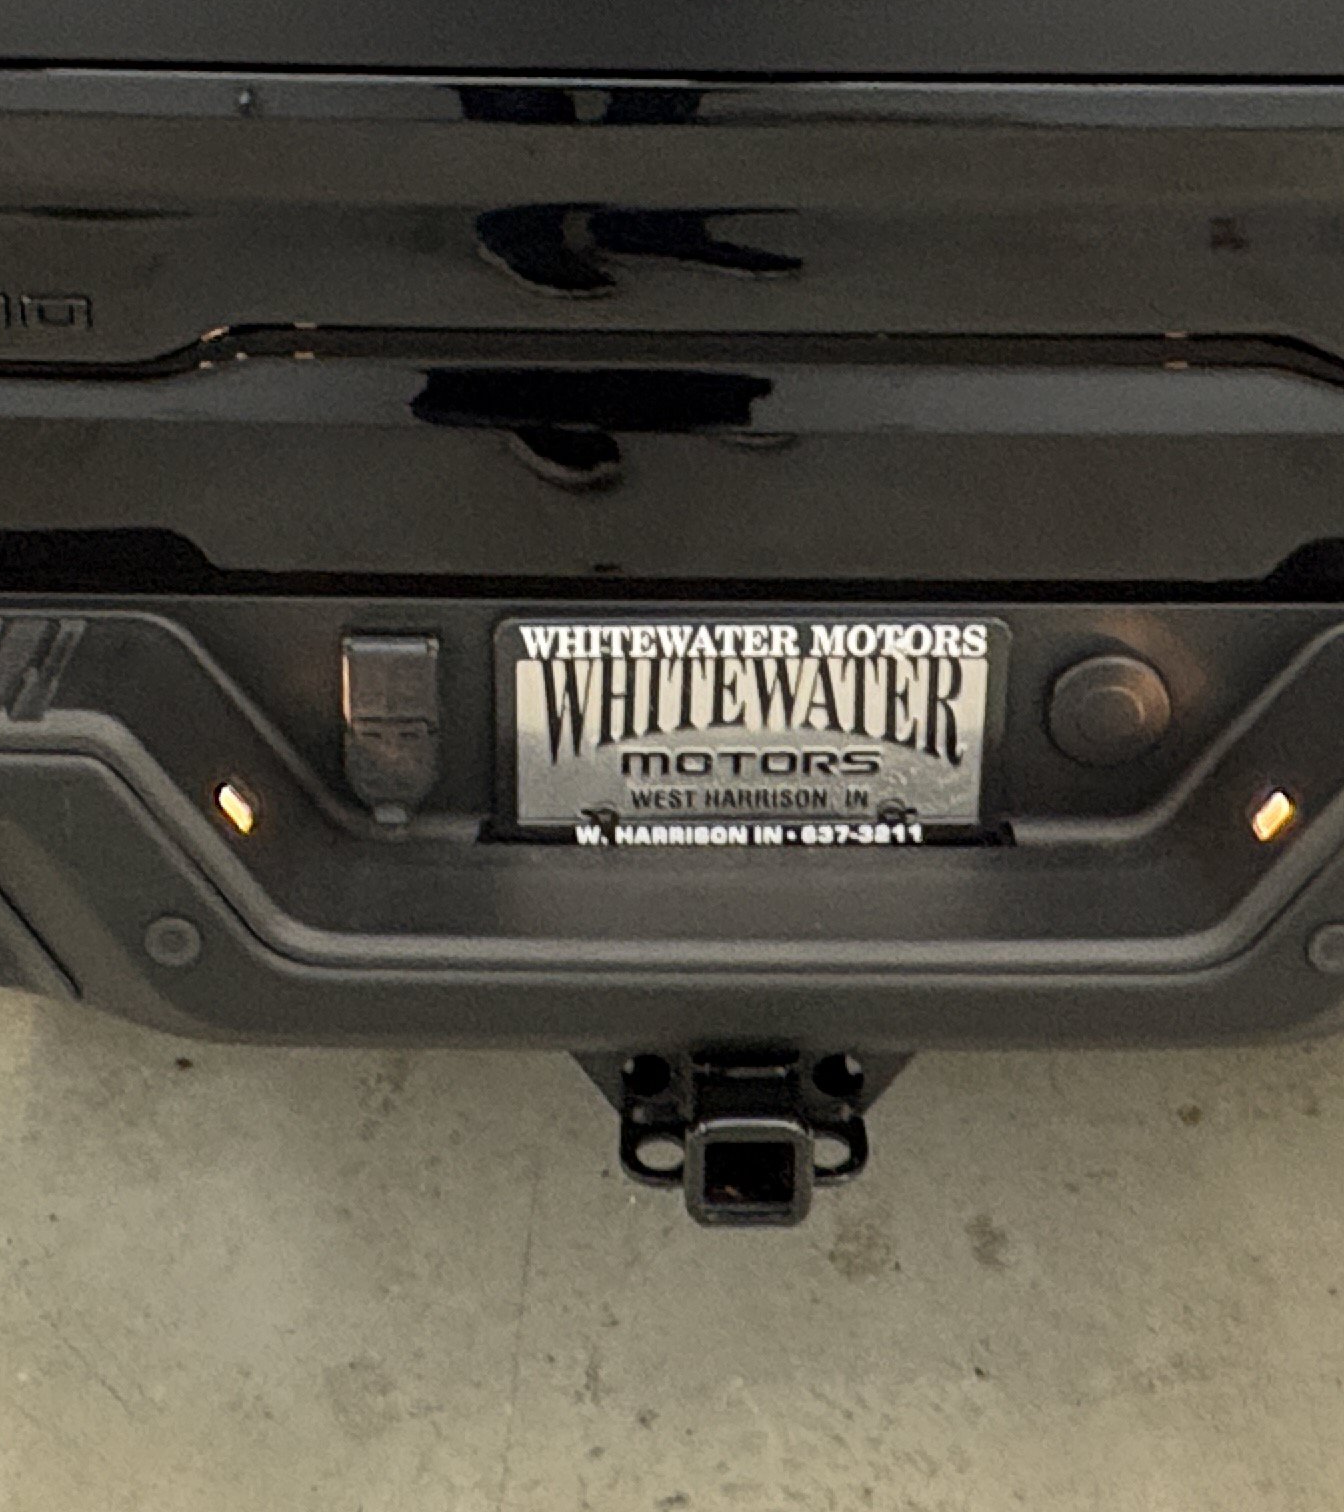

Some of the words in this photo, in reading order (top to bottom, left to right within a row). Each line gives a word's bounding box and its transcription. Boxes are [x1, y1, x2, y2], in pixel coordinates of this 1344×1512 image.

[520, 626, 799, 659] WHITEWATER
[810, 625, 987, 658] MOTORS
[540, 657, 964, 767] WHITEWATER
[620, 750, 882, 777] MOTORS
[630, 788, 694, 809] WEST
[845, 789, 869, 808] IN
[614, 825, 748, 845] HARRISON
[755, 825, 783, 845] IN
